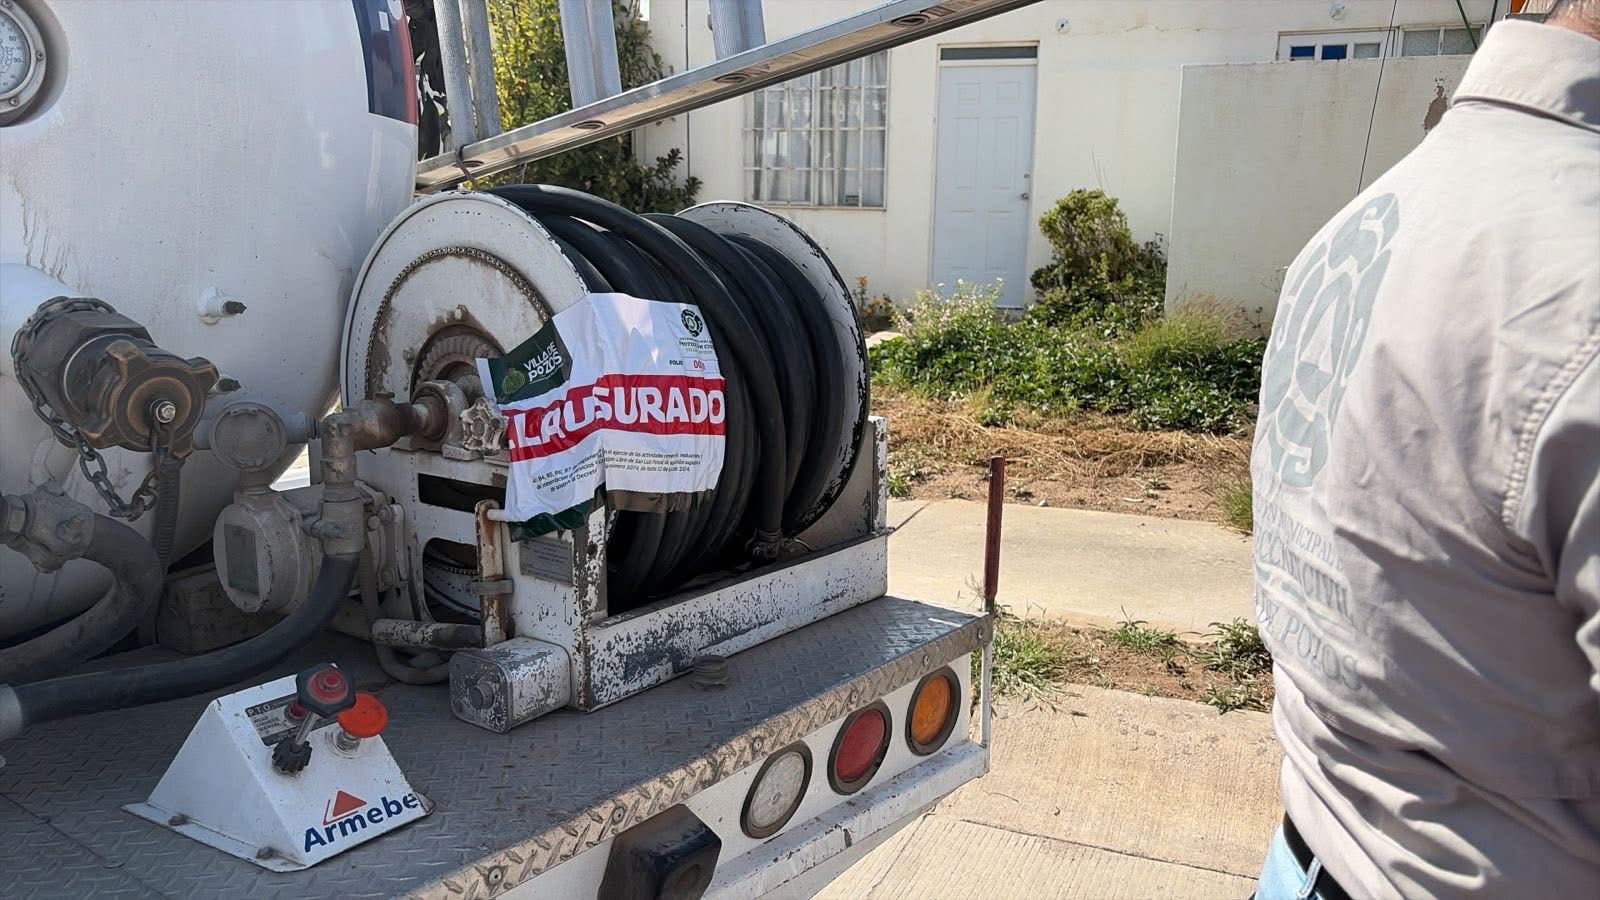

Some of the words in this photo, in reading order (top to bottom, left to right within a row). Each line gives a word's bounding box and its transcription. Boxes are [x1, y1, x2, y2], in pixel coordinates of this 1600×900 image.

[523, 351, 549, 371] VILLA
[546, 341, 557, 356] DE
[528, 351, 562, 382] POZOS
[509, 386, 725, 449] LAUSURADO
[304, 793, 418, 853] Armebe
